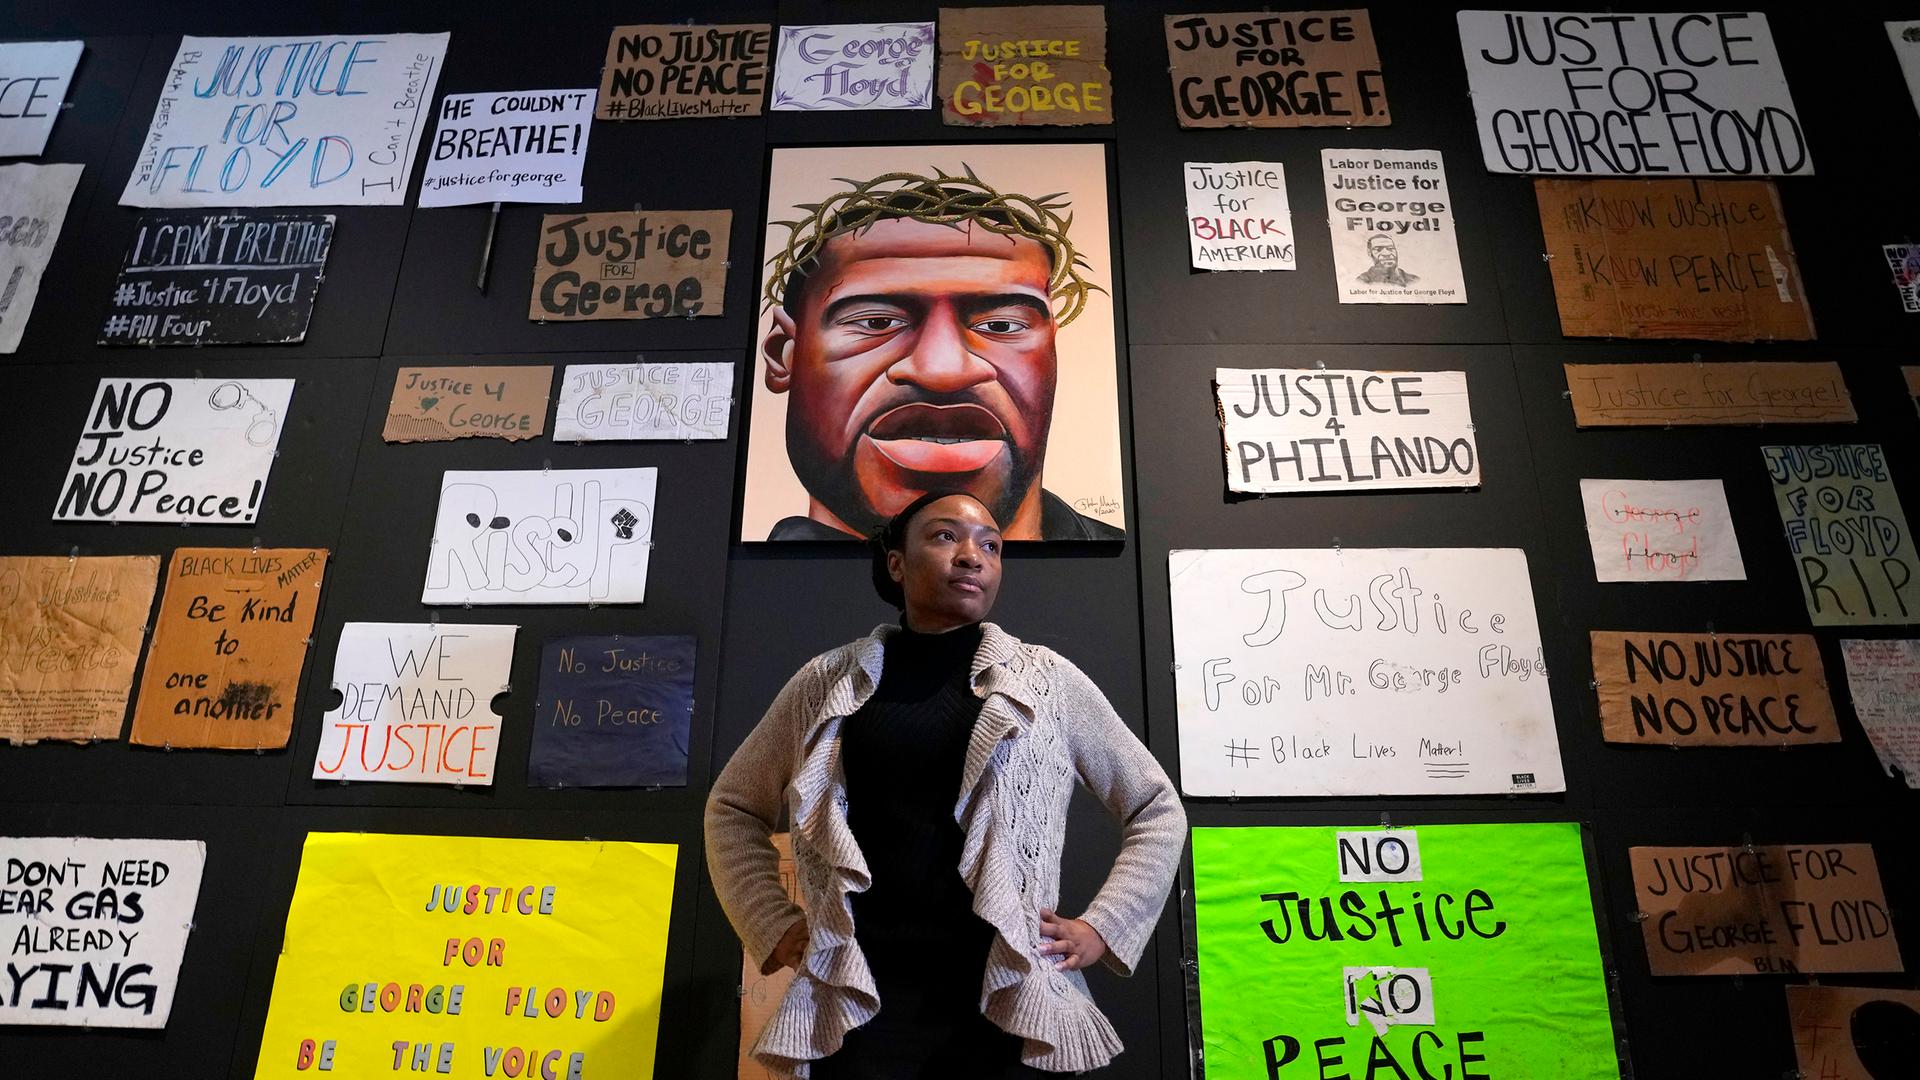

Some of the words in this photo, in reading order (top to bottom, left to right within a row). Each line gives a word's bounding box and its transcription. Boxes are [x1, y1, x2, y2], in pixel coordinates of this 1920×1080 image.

[617, 34, 662, 63] NO
[660, 29, 769, 65] JUSTICE
[962, 39, 1081, 60] JUSTICE
[1173, 17, 1355, 51] JUSTICE
[1481, 13, 1759, 67] JUSTICE
[194, 40, 387, 99] JUSTICE
[993, 61, 1055, 82] FOR
[1236, 48, 1304, 66] FOR
[0, 77, 59, 118] CE
[394, 53, 428, 109] Breathe
[610, 67, 654, 97] NO
[660, 62, 763, 95] PEACE
[953, 80, 1105, 115] GEORGE
[1179, 71, 1351, 119] GEORGE
[1357, 70, 1386, 116] F.
[1563, 67, 1715, 113] FOR
[221, 102, 298, 146] FOR
[443, 98, 474, 120] HE
[491, 94, 586, 115] COULDN'T
[369, 119, 406, 165] Can't
[435, 124, 581, 161] BREATHE!
[1492, 109, 1669, 173] GEORGE
[1668, 107, 1806, 174] FLOYD
[150, 136, 354, 194] FLOYD
[1190, 167, 1279, 189] Justice
[1329, 159, 1370, 170] Labor
[1374, 159, 1438, 170] Demands
[1333, 175, 1406, 190] Justice
[1412, 176, 1440, 190] for
[362, 177, 394, 196] I
[1213, 194, 1255, 214] for
[1334, 198, 1446, 216] George
[1579, 197, 1655, 228] KNOW
[132, 226, 147, 265] I
[235, 222, 330, 264] BREATHE
[546, 216, 711, 266] Justice
[1191, 217, 1286, 240] BLACK
[1346, 217, 1441, 234] Floyd!
[604, 265, 632, 277] FOR
[1199, 244, 1293, 262] AMERICANS
[1587, 253, 1658, 288] KNOW
[1669, 253, 1770, 292] PEACE
[114, 281, 199, 306] #Justice
[540, 271, 703, 317] George
[104, 315, 157, 338] #All
[161, 315, 211, 337] Four
[485, 382, 505, 401] 4
[574, 366, 680, 393] JUSTICE
[691, 367, 713, 396] 4
[1233, 374, 1430, 419] JUSTICE
[1578, 372, 1689, 408] Justice
[1703, 373, 1734, 405] for
[92, 381, 172, 430] NO
[576, 394, 725, 429] GEORGE
[1325, 417, 1345, 435] 4
[77, 432, 203, 466] Justice
[1237, 437, 1474, 483] PHILANDO
[1766, 446, 1888, 485] JUSTICE
[58, 469, 127, 517] NO
[130, 470, 262, 520] Peace!
[1602, 490, 1701, 535] George
[1787, 486, 1874, 517] FOR
[1788, 516, 1900, 557] FLOYD
[180, 557, 235, 577] BLACK
[241, 557, 282, 574] LIVES
[277, 552, 321, 589] MATTER
[187, 597, 225, 623] Be
[241, 591, 298, 623] Kind
[1241, 567, 1505, 647] Justice
[215, 630, 239, 656] to
[388, 634, 469, 680] WE
[558, 648, 585, 673] No
[602, 649, 681, 673] Justice
[166, 672, 208, 689] one
[1203, 658, 1280, 712] For
[1305, 664, 1355, 701] Mr.
[1479, 644, 1548, 682] Floyd
[1625, 639, 1686, 684] NO
[1690, 639, 1803, 687] JUSTICE
[174, 697, 282, 721] another
[342, 683, 475, 722] DEMAND
[552, 700, 581, 727] No
[598, 699, 664, 726] Peace
[1630, 693, 1697, 737] NO
[1702, 693, 1818, 736] PEACE
[319, 724, 494, 777] JUSTICE
[1271, 735, 1330, 764] Black
[1352, 733, 1396, 758] Lives
[1419, 737, 1463, 758] Matter!
[7, 857, 86, 887] DON'T
[101, 860, 170, 887] NEED
[1339, 837, 1410, 875] NO
[1647, 851, 1780, 895] JUSTICE
[1786, 849, 1857, 881] FOR
[0, 888, 55, 916] EAR
[65, 887, 144, 924] GAS
[426, 884, 556, 915] JUSTICE
[1259, 889, 1506, 947] Justice
[1658, 910, 1777, 954] GEORGE
[1780, 899, 1889, 946] FLOYD
[11, 925, 139, 957] ALREADY
[443, 937, 506, 966] FOR
[1753, 957, 1800, 974] BLM
[0, 962, 158, 1015] YING
[340, 982, 465, 1015] GEORGE
[505, 986, 615, 1022] FLOYD
[296, 1039, 336, 1071] BE
[392, 1040, 454, 1073] THE
[484, 1046, 584, 1080] VOICE
[1262, 1031, 1490, 1080] PEACE
